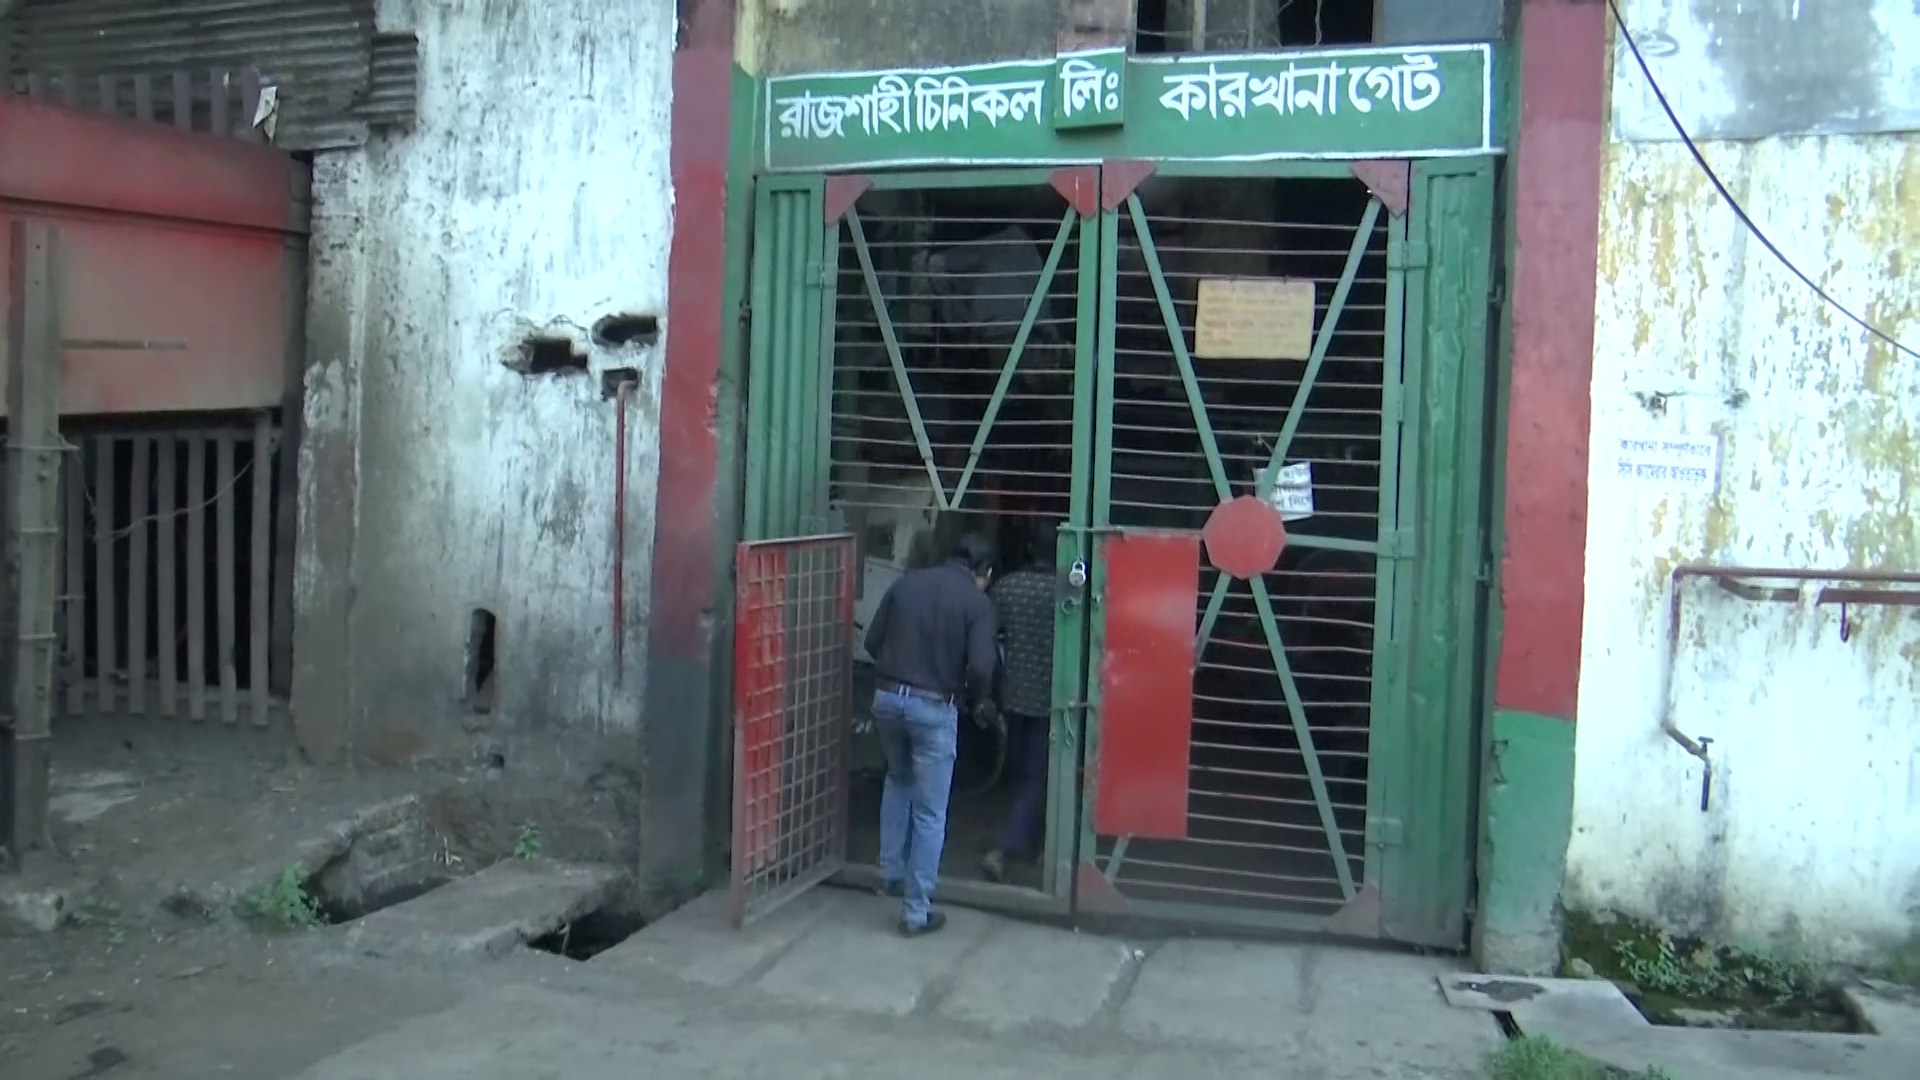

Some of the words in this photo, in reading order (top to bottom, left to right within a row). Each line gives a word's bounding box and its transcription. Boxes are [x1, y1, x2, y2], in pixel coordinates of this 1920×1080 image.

[776, 75, 911, 140] রাজশাহী
[1158, 61, 1346, 121] কারখানা
[1348, 54, 1441, 113] গেট
